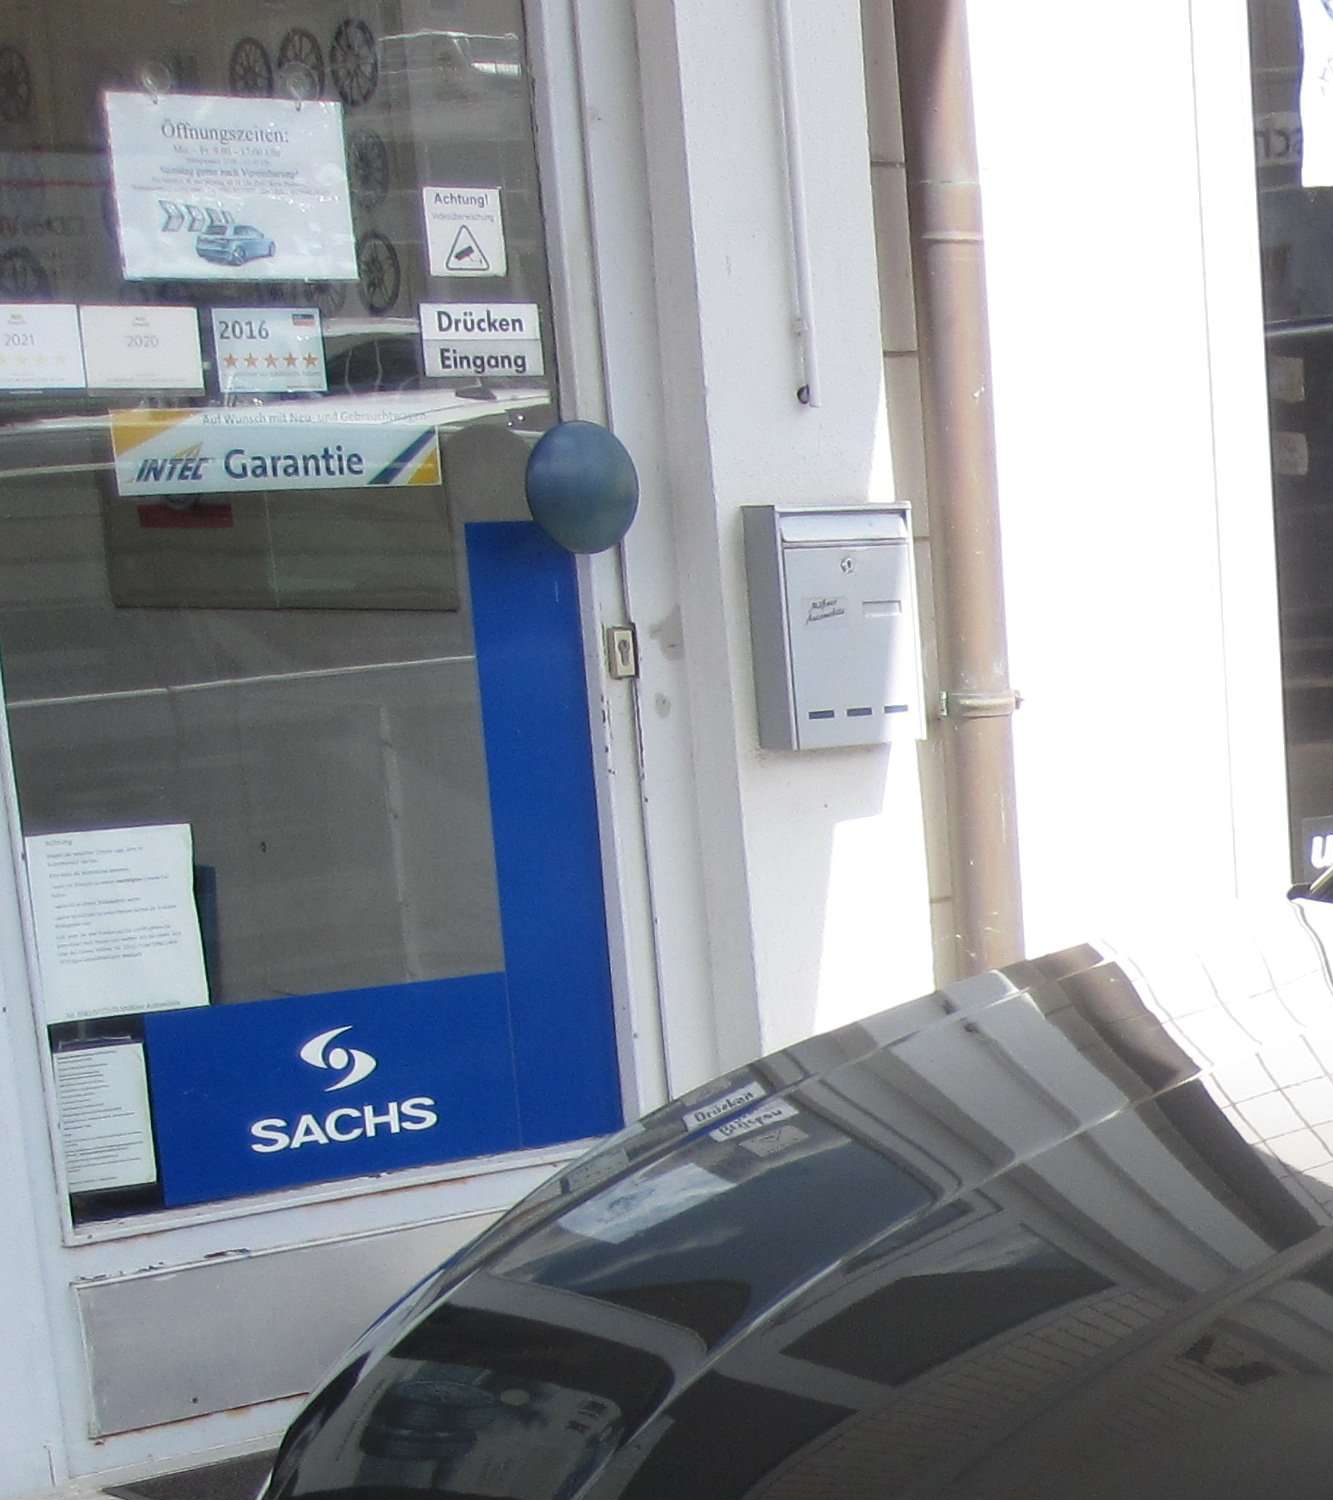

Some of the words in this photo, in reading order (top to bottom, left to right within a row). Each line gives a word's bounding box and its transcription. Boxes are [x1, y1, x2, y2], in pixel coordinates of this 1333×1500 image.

[161, 119, 289, 144] Öffnungszeiten:
[434, 193, 488, 208] Achtung!
[219, 320, 269, 340] 2016
[437, 310, 523, 333] Drücken
[4, 333, 34, 346] 2021
[127, 335, 159, 348] 2020
[440, 348, 527, 373] Eingang
[135, 457, 208, 482] INTEC
[224, 445, 364, 479] Garantie
[251, 1096, 438, 1153] SACHS
